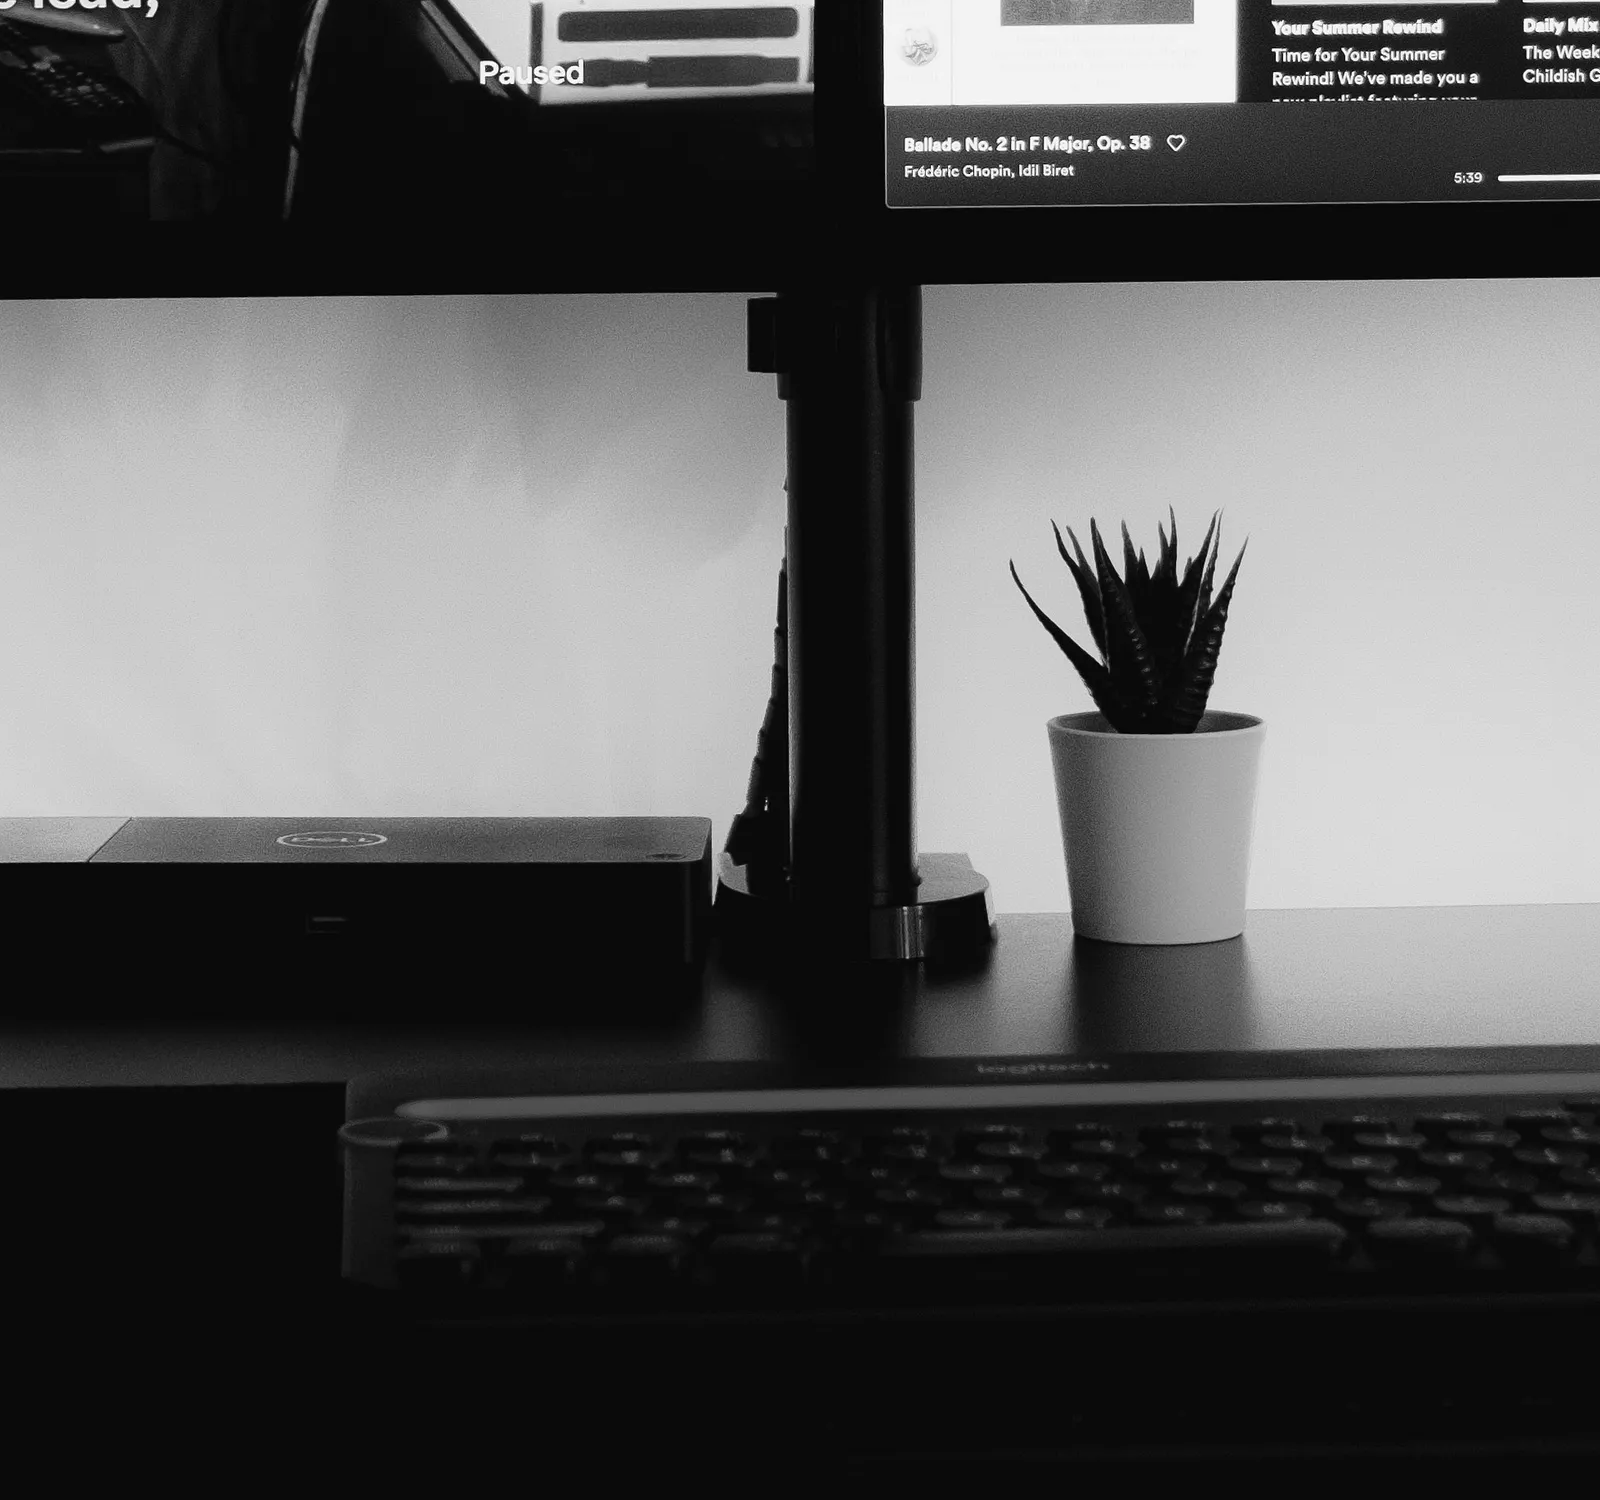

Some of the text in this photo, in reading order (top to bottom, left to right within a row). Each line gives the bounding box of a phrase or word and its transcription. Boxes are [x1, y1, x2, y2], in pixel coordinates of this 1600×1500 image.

[480, 61, 584, 84] Paused
[1523, 69, 1585, 83] Childish
[905, 135, 1151, 153] Ballade No. 2 in F Major, Op. 38
[905, 164, 1074, 179] Frédéric Chopin, Idil Biret
[1454, 172, 1483, 183] 5:39
